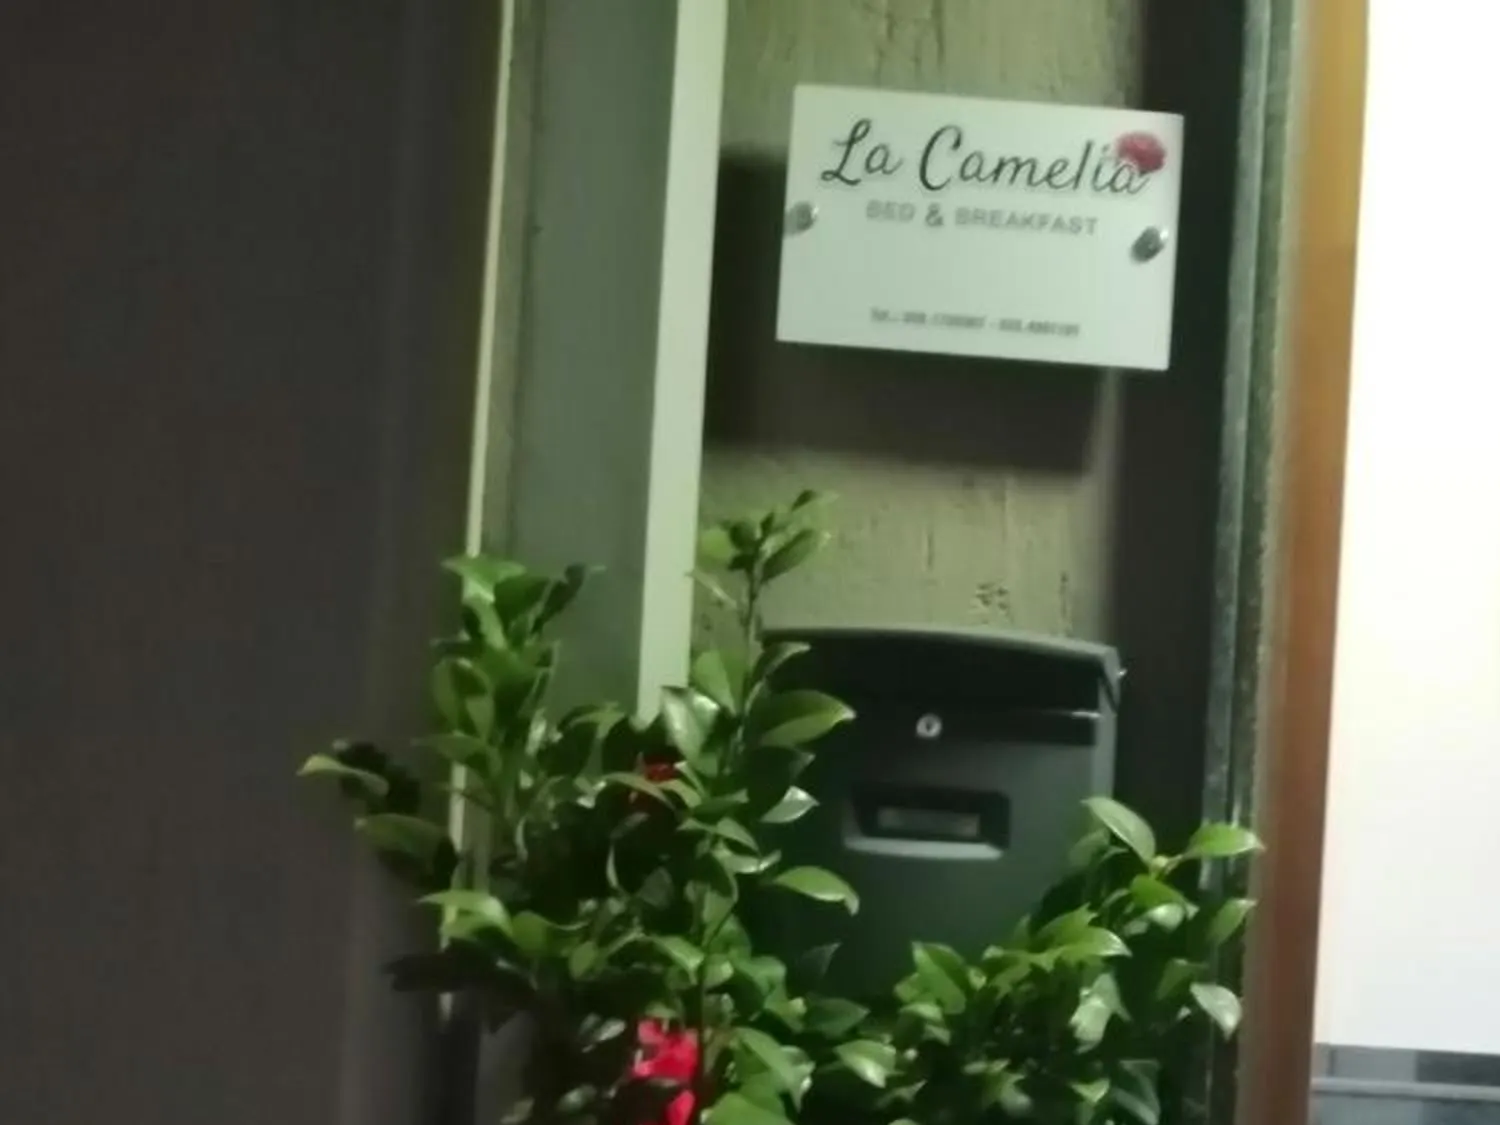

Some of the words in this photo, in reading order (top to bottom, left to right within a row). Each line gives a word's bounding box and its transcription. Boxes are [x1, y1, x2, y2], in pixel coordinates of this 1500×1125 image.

[821, 118, 901, 186] La
[919, 125, 1150, 195] Camelia
[866, 200, 916, 222] BED
[924, 203, 945, 228] &
[954, 206, 1099, 236] BREAKFAST
